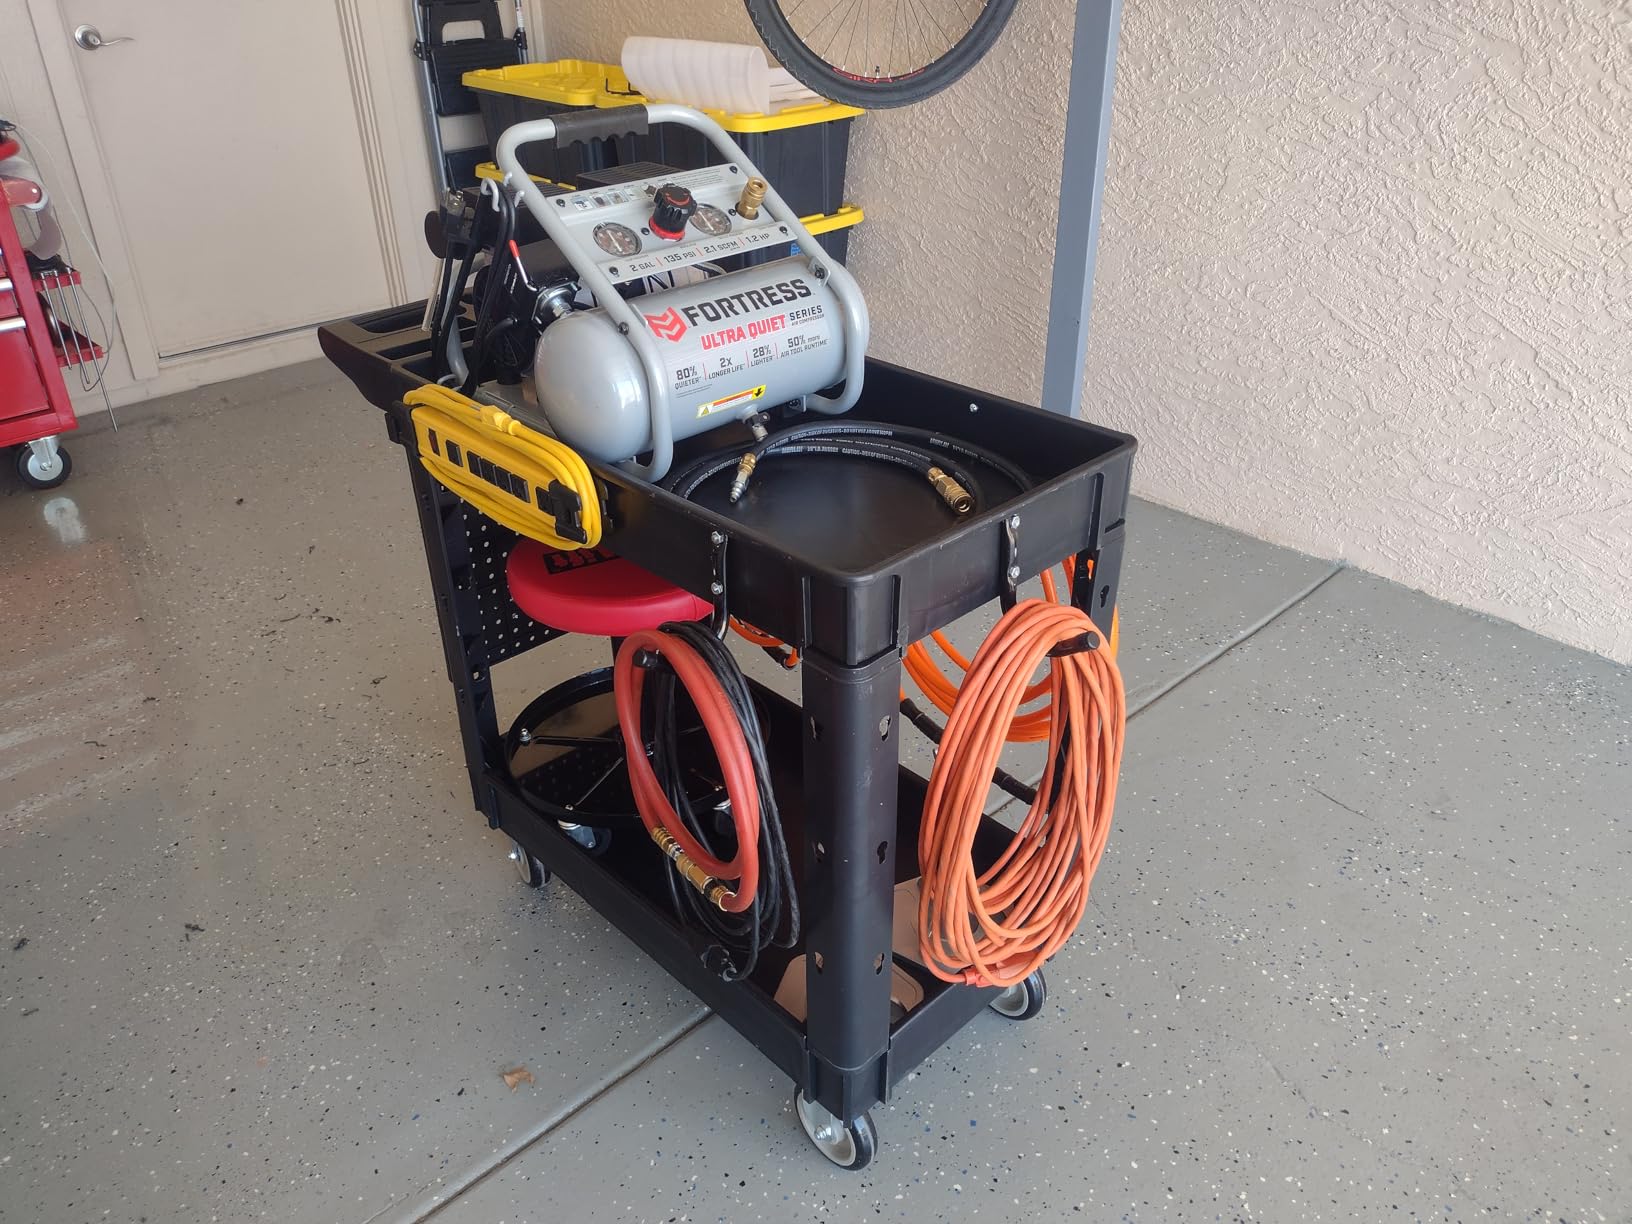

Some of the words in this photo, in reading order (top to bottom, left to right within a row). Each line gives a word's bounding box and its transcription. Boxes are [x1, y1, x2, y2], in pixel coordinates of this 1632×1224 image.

[745, 234, 760, 244] 1.2
[759, 232, 770, 241] HP
[703, 245, 716, 254] 2.1
[718, 240, 738, 251] SCFM
[663, 253, 682, 264] 135
[682, 250, 697, 259] PSI
[629, 263, 638, 272] 2
[638, 261, 656, 270] GAL
[681, 278, 812, 327] FORTRESS
[701, 326, 747, 350] ULTRA
[747, 314, 786, 340] QUIET
[789, 304, 823, 321] SERIES
[787, 334, 806, 348] 50%
[752, 344, 772, 359] 28%
[780, 350, 790, 359] AIR
[790, 346, 803, 356] TOOL
[804, 339, 828, 350] RUNTIME
[750, 356, 773, 367] LIGHTER
[676, 365, 697, 381] 80%
[708, 367, 731, 380] LONGER
[731, 363, 744, 374] LIFE
[674, 377, 700, 390] QUIETER
